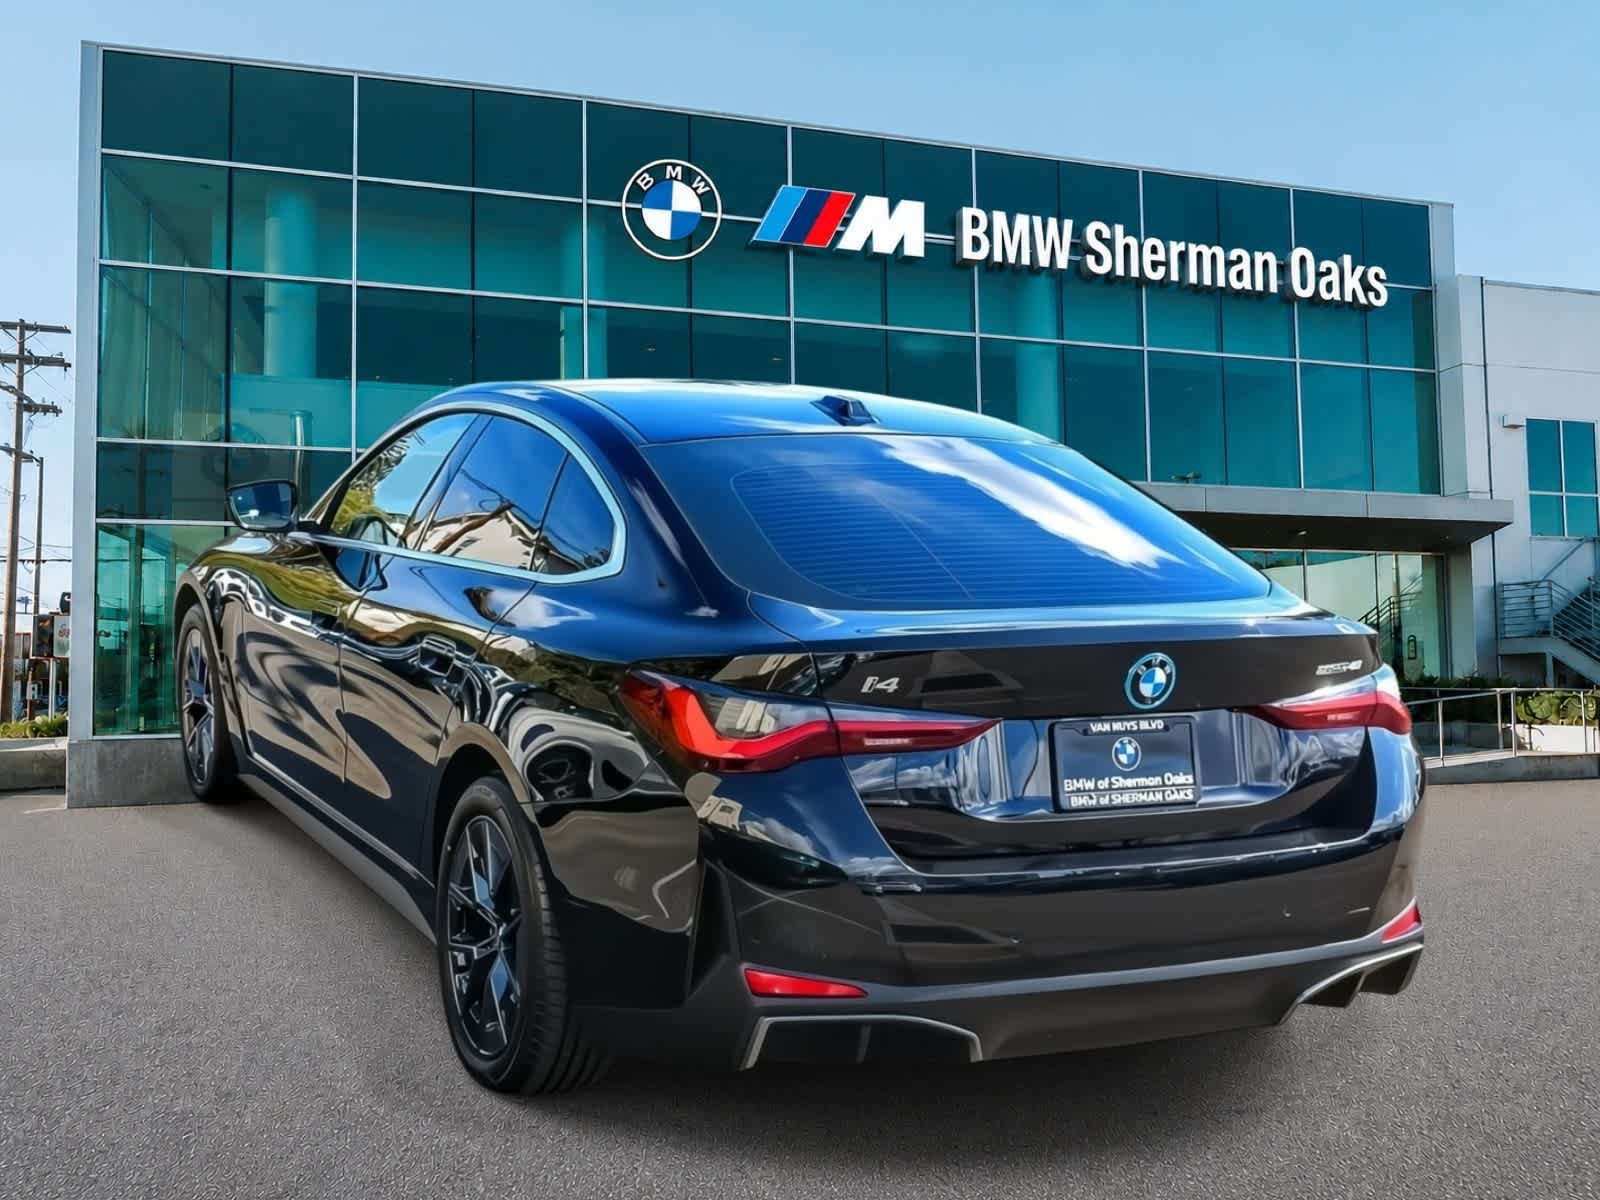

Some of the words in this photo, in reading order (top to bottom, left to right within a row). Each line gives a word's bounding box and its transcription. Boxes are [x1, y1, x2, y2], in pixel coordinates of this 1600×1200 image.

[636, 165, 711, 194] BMW
[960, 206, 1073, 270] BMW
[1083, 220, 1278, 293] Sherman
[1288, 246, 1388, 308] Oaks
[1089, 721, 1111, 733] VAN
[1112, 720, 1138, 731] NUYS
[1063, 778, 1096, 792] BMW
[1097, 777, 1109, 790] of
[1110, 775, 1162, 789] Sherman
[1163, 772, 1194, 785] Oaks
[1070, 793, 1097, 807] BMW
[1099, 792, 1110, 805] of
[1110, 789, 1163, 805] SHERMAN
[1164, 787, 1194, 801] OAKS
